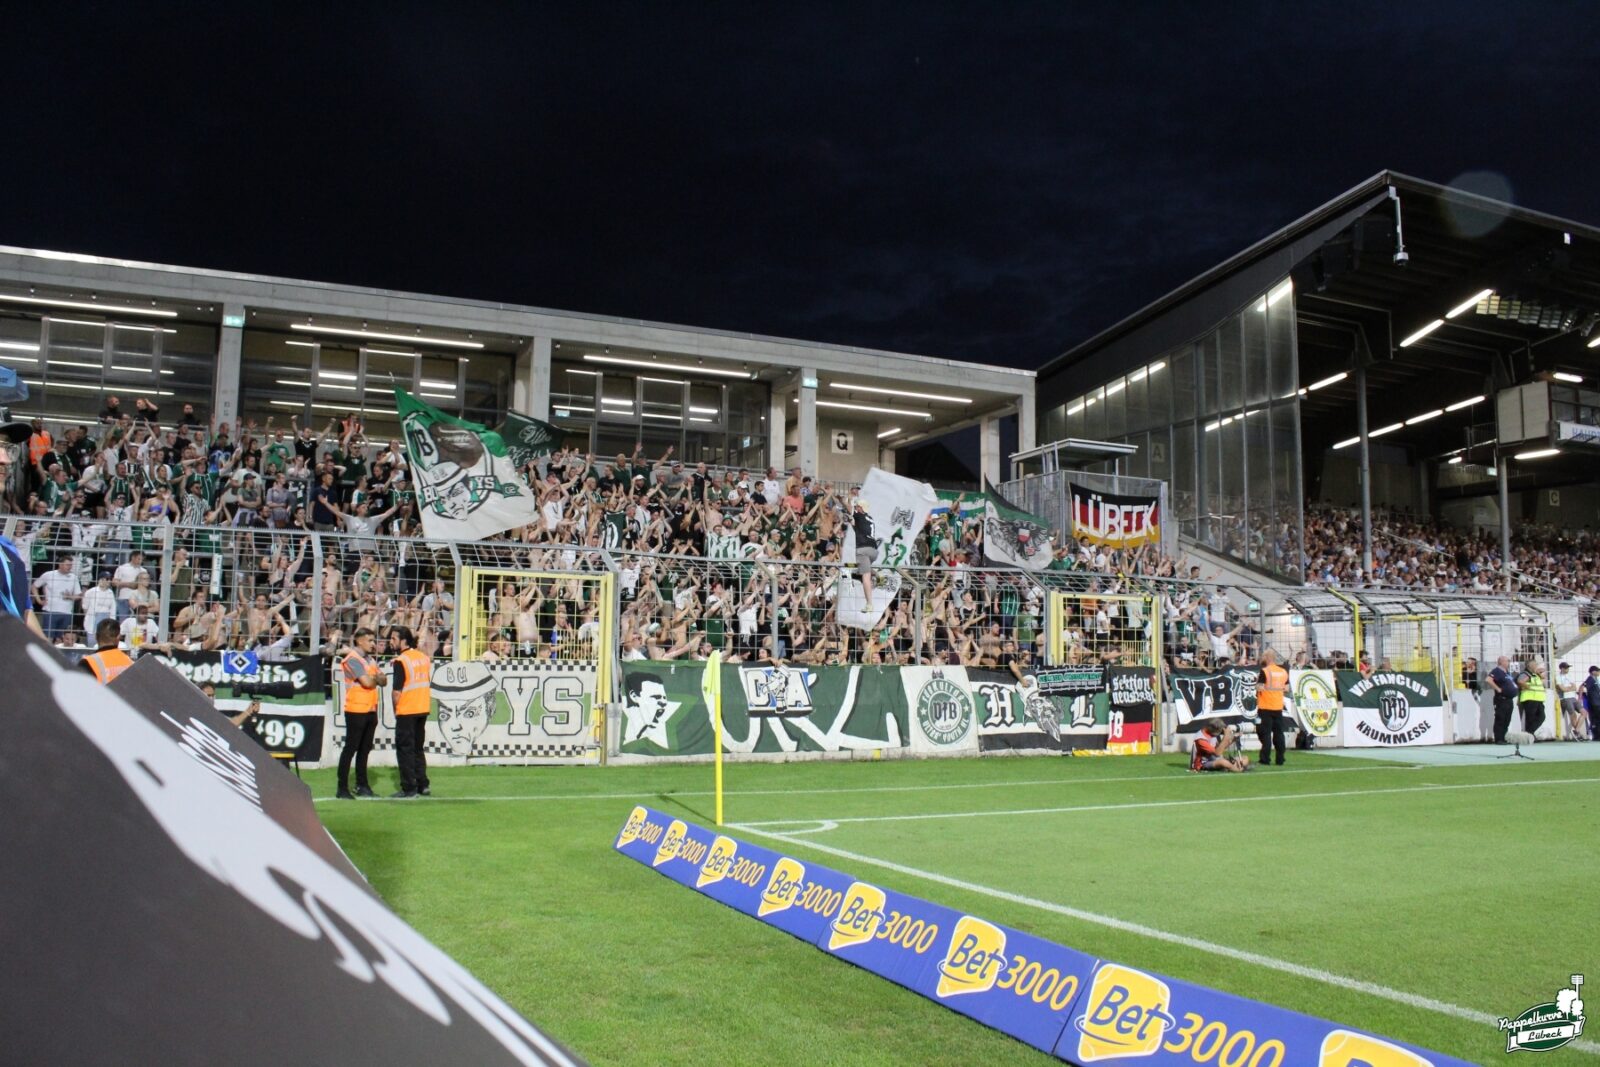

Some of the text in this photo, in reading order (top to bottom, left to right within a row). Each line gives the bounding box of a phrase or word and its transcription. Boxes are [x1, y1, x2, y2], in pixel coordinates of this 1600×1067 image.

[836, 431, 849, 452] Q
[1074, 493, 1157, 541] LÜBECK
[501, 676, 584, 737] YS
[1371, 673, 1429, 697] FANCLUB
[1356, 720, 1431, 744] KRUMMESSE
[705, 847, 766, 887] Bet 3000
[768, 869, 842, 917] Bet 3000
[838, 896, 939, 954] Bet 3000
[948, 933, 1078, 1011] Bet 3000
[1089, 985, 1165, 1041] Bet
